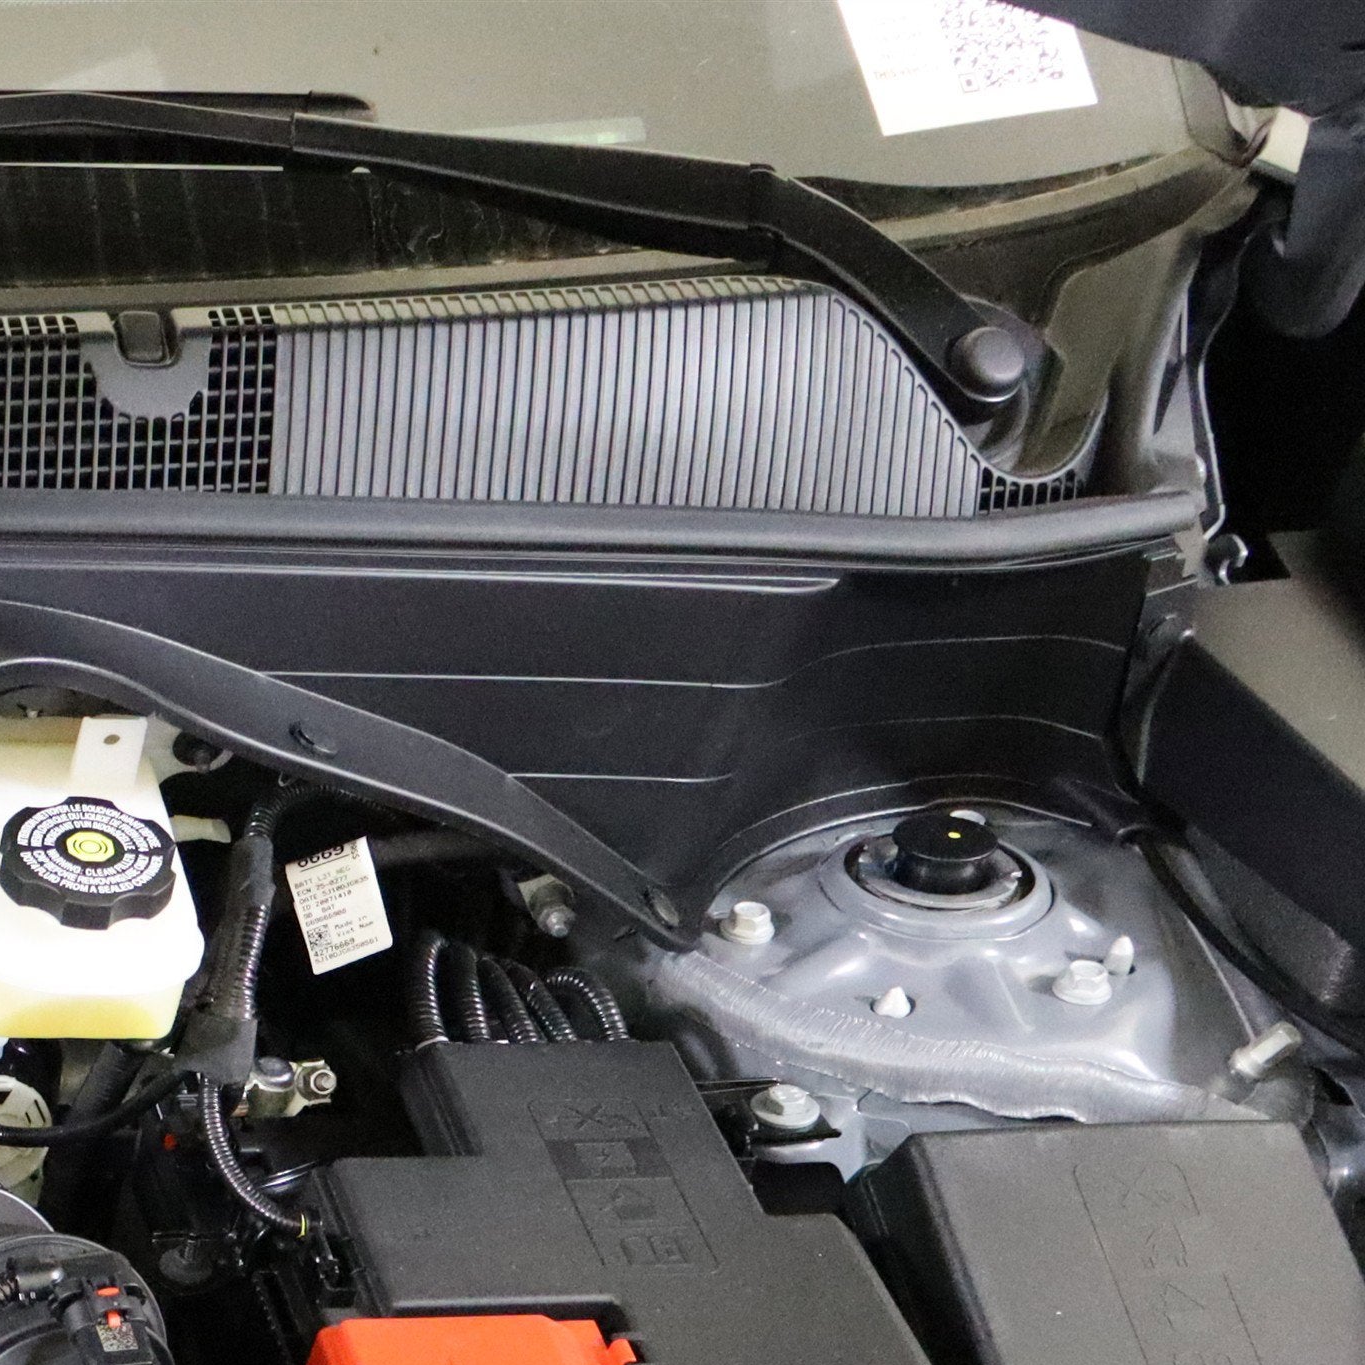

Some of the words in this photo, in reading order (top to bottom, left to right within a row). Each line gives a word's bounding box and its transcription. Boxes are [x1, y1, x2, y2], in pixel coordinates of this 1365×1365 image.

[70, 803, 82, 813] LE
[68, 811, 80, 821] DU
[85, 866, 118, 877] CLEAN
[59, 879, 89, 894] FROM
[89, 884, 98, 894] A
